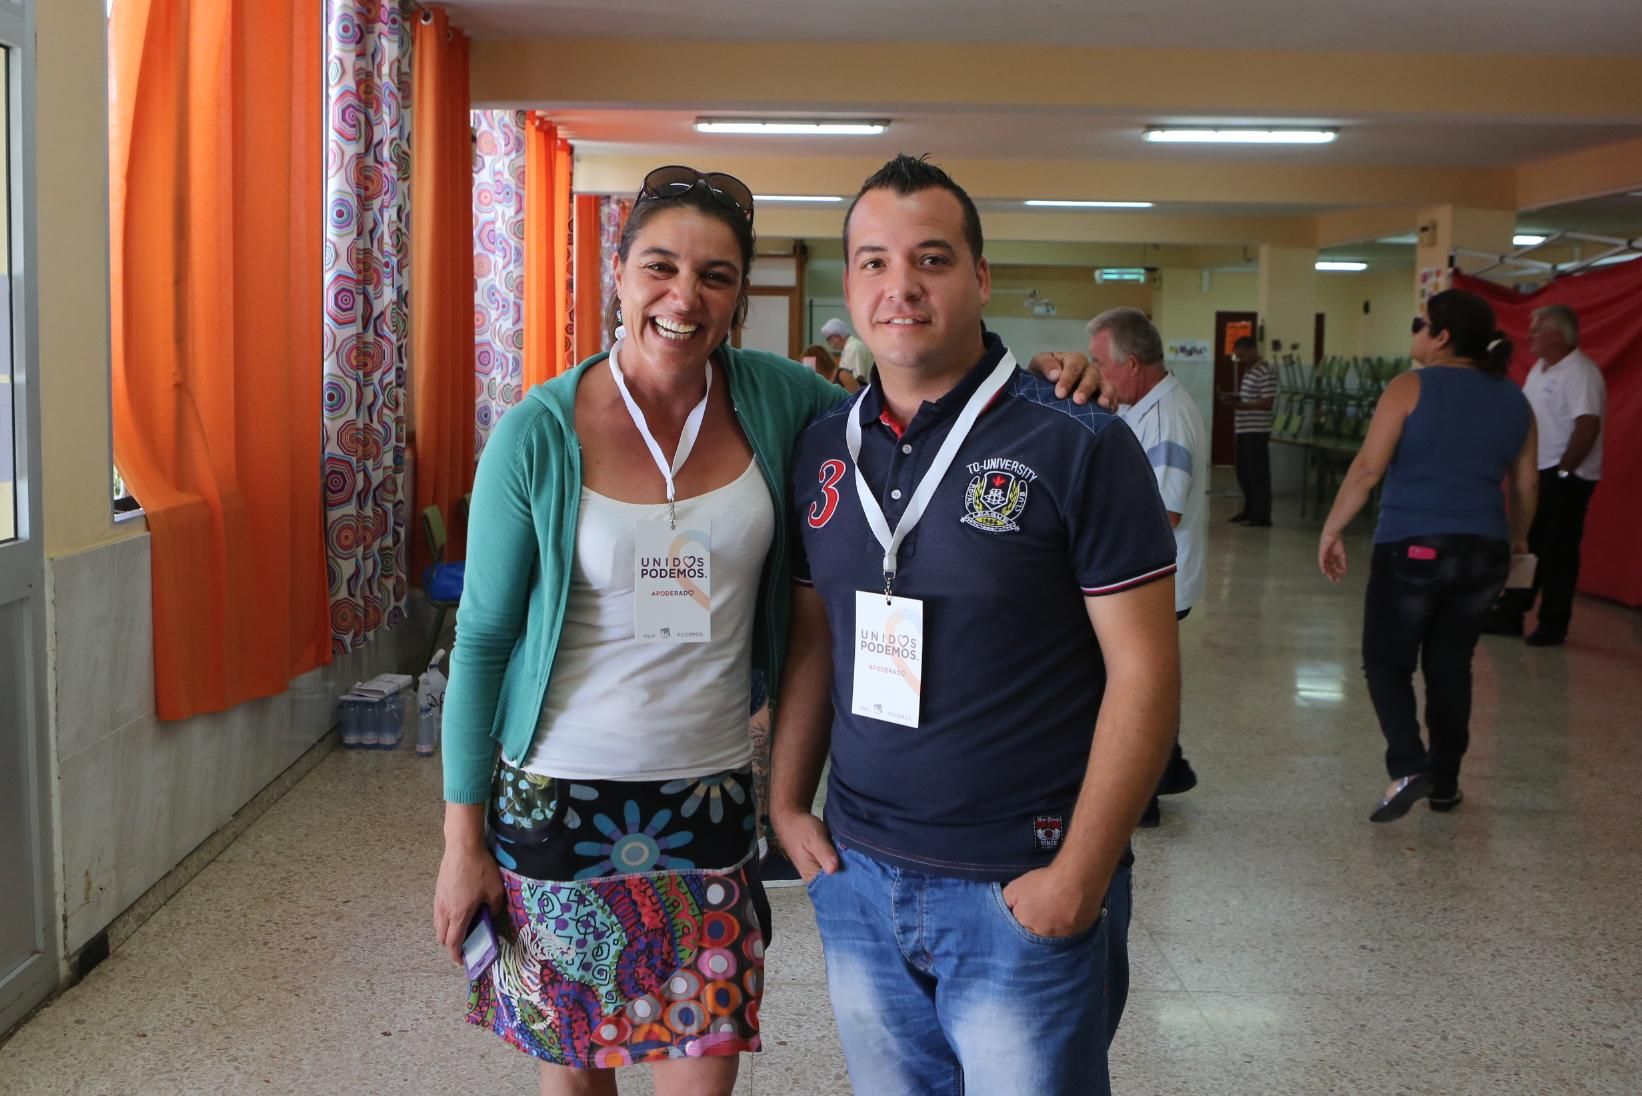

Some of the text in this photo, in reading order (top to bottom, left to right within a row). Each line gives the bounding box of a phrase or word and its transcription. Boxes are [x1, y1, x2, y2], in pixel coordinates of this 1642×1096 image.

[966, 458, 1038, 482] TO-UNIVERSITY
[808, 459, 846, 528] 3
[1014, 491, 1026, 512] CLUB
[641, 568, 708, 579] PODEMOS.
